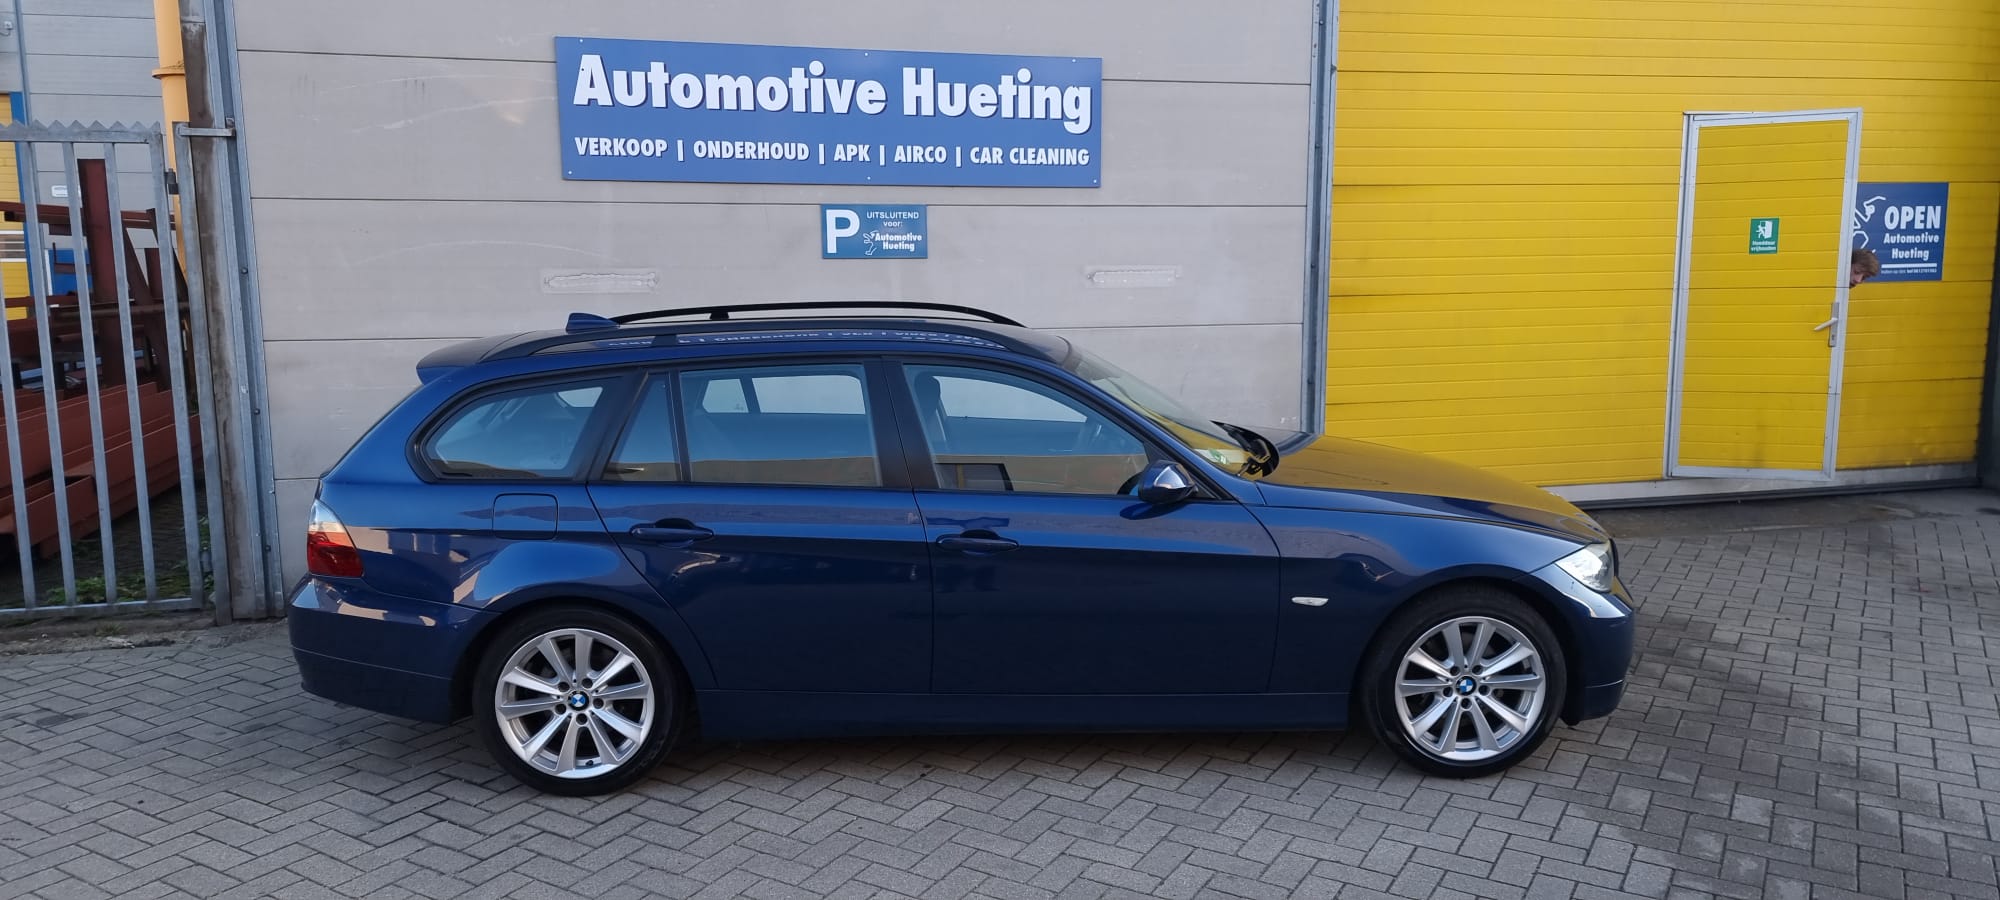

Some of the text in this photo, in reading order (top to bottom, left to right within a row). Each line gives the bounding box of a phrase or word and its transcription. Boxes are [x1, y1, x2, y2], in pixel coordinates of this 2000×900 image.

[573, 54, 1092, 134] Automotive Hueting
[575, 137, 668, 157] VERKOOP
[693, 140, 810, 160] ONDERHOUD
[833, 144, 871, 162] APK
[894, 145, 948, 163] AIRCO
[970, 147, 1004, 164] CAR
[1009, 148, 1090, 166] CLEANING
[866, 211, 920, 219] UITSLUITEND
[1884, 205, 1941, 230] OPEN
[826, 209, 860, 254] P
[874, 232, 923, 241] Automotive
[1883, 232, 1940, 244] Automotive
[882, 241, 915, 252] Hueting
[1891, 247, 1930, 261] Hueting
